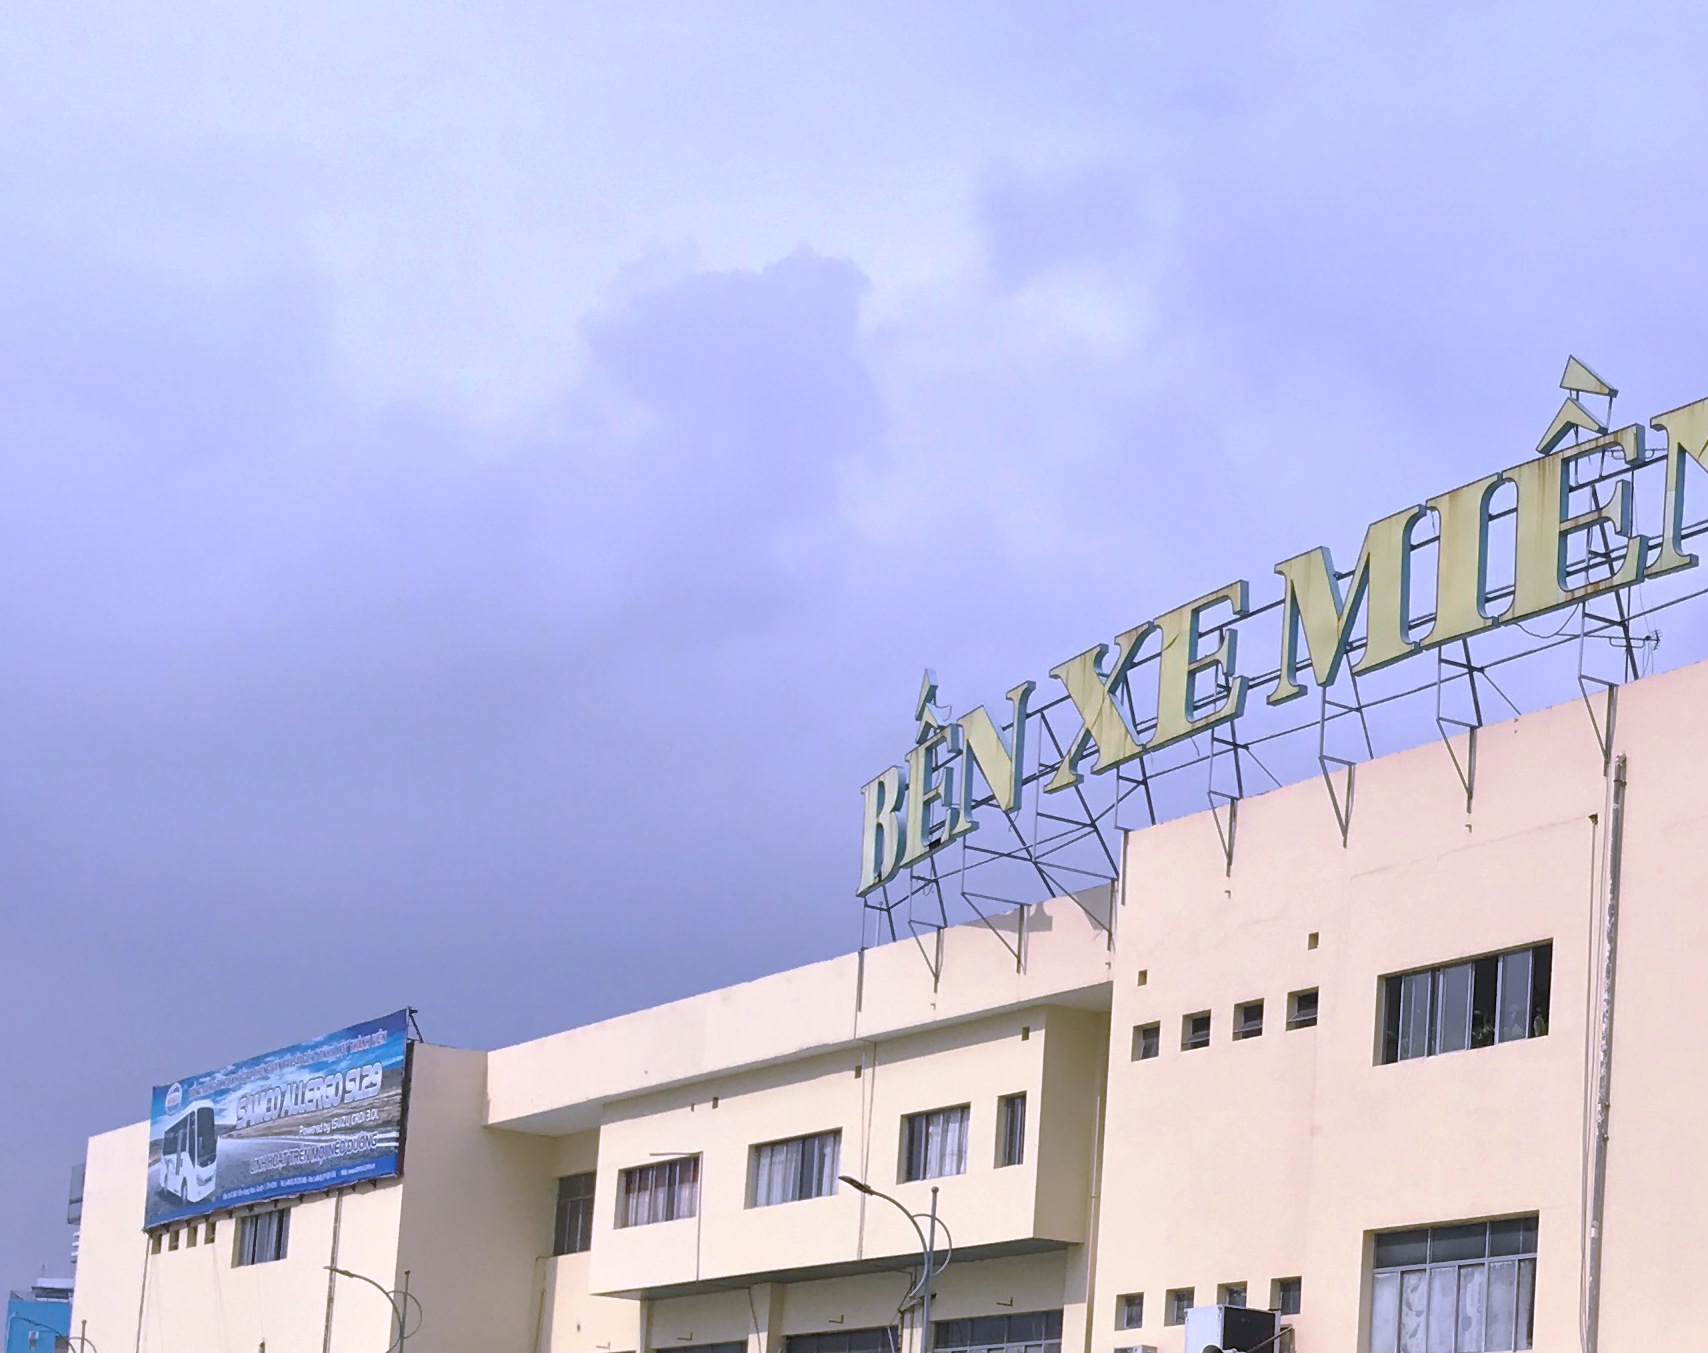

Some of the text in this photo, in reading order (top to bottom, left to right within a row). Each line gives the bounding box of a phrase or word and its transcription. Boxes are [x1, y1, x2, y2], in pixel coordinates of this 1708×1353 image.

[856, 668, 1036, 897] BẾN
[1042, 579, 1249, 793] XE
[236, 1086, 280, 1129] SAMCO
